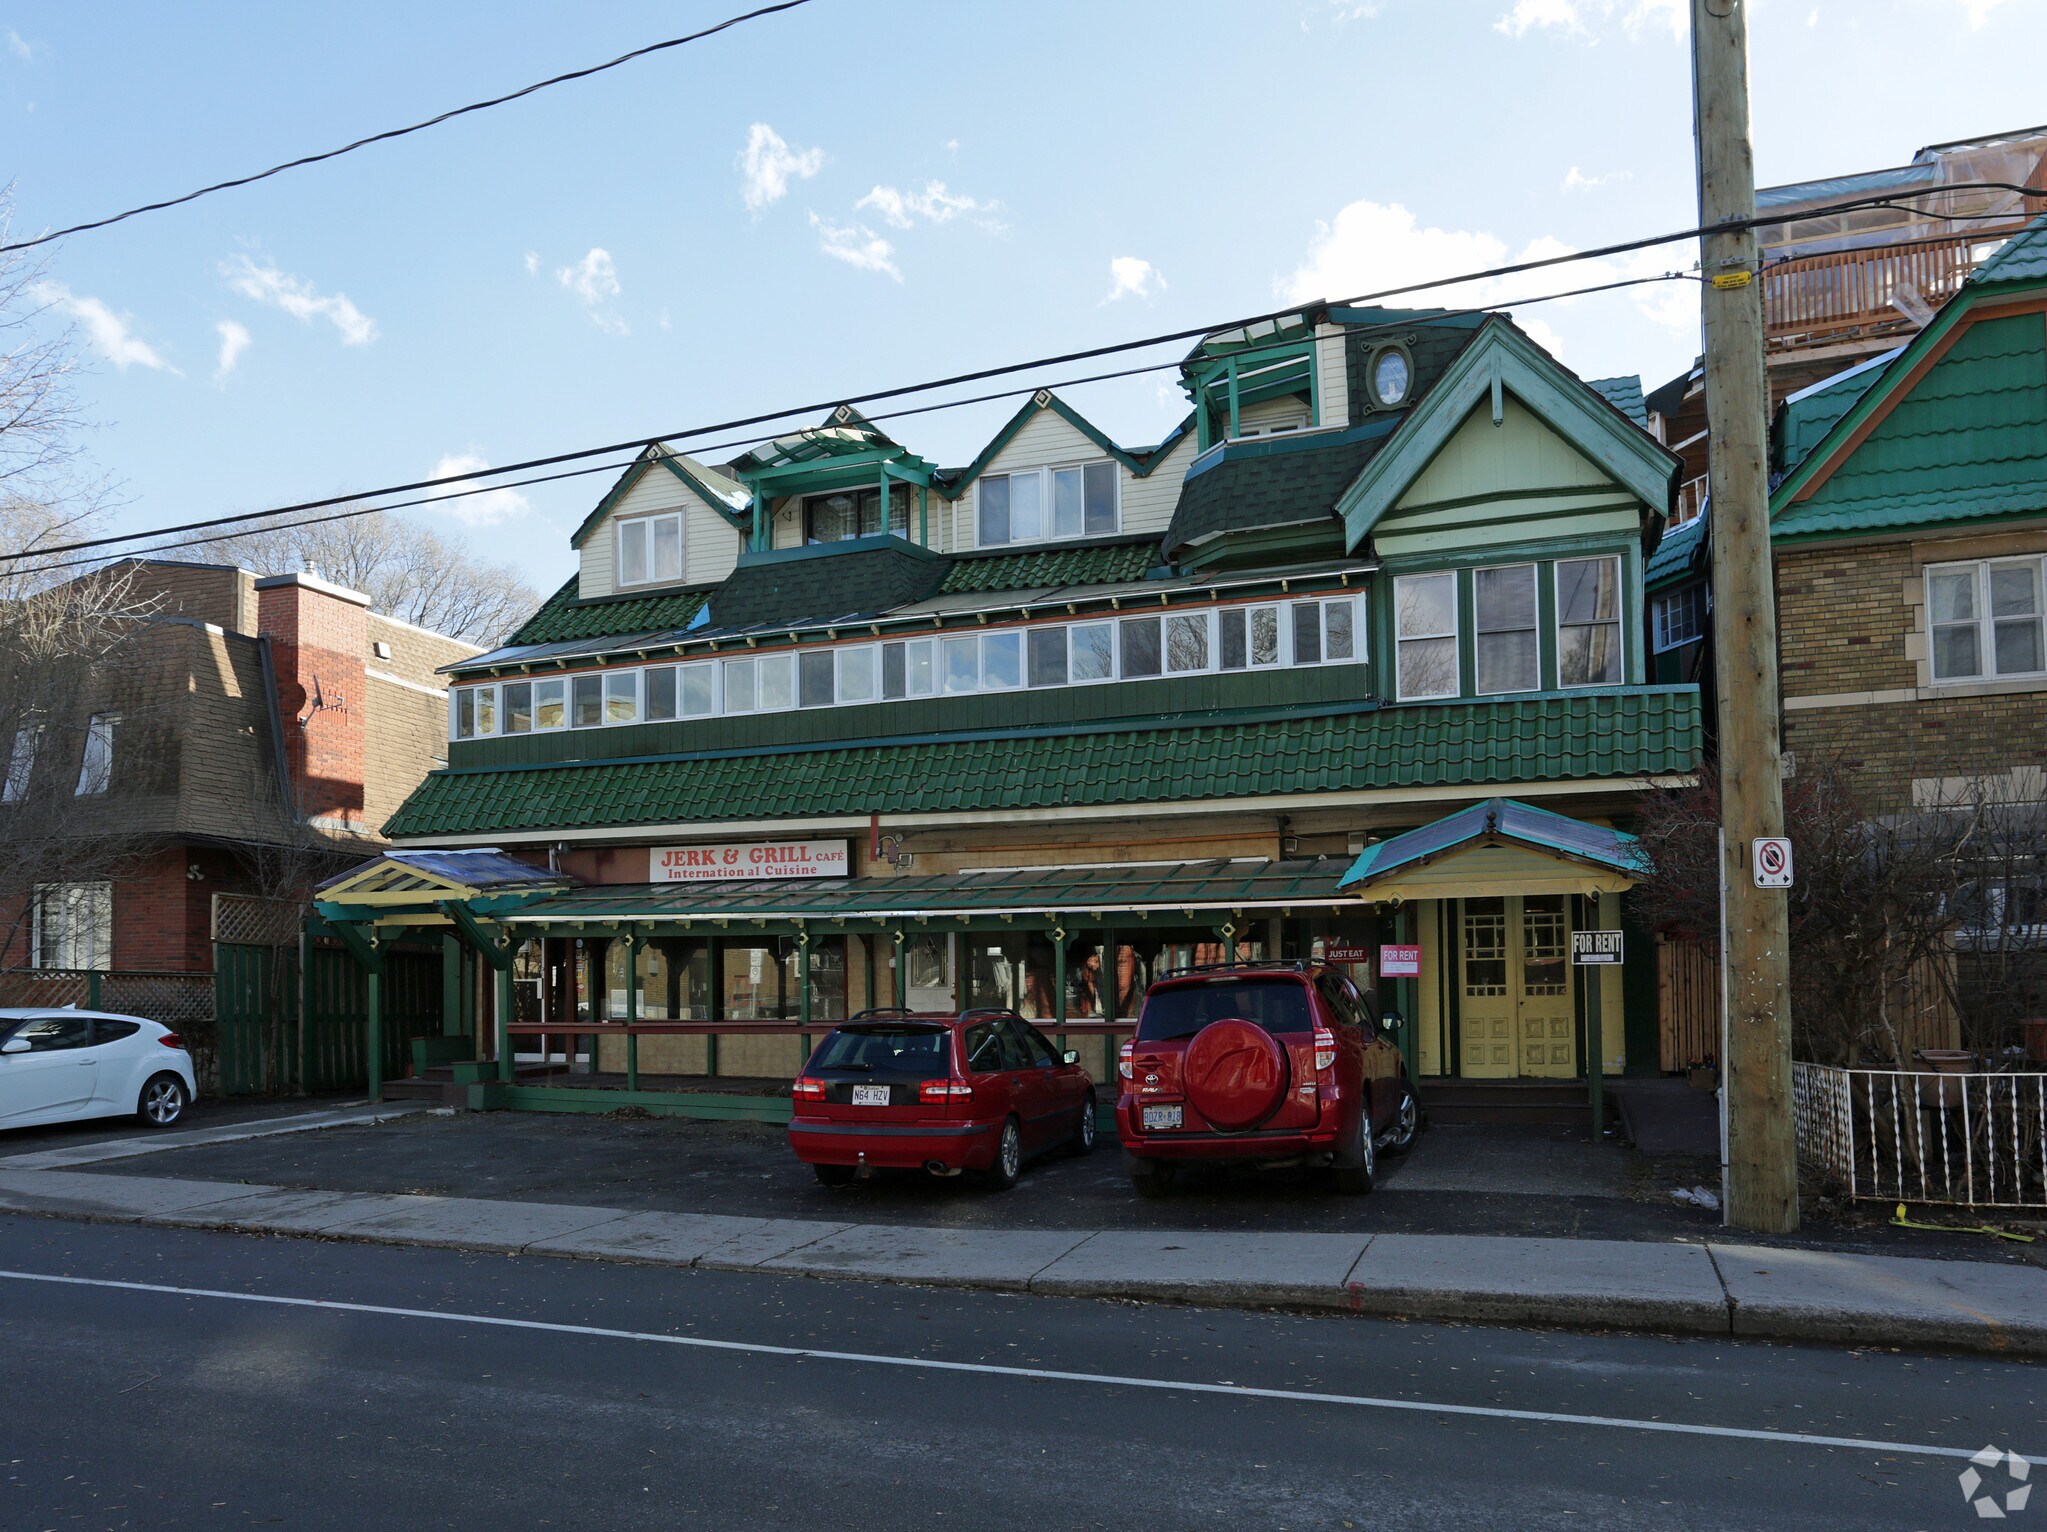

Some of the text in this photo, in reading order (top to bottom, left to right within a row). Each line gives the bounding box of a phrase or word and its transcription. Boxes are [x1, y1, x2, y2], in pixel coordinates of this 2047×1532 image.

[661, 846, 844, 867] JERK & GRILL CAFÉ
[764, 865, 817, 876] Cuisine
[1573, 933, 1620, 953] FOR RENT
[1328, 949, 1364, 958] JUST EAT
[1383, 950, 1418, 961] FOR RENT
[854, 1090, 888, 1101] N64 HZV
